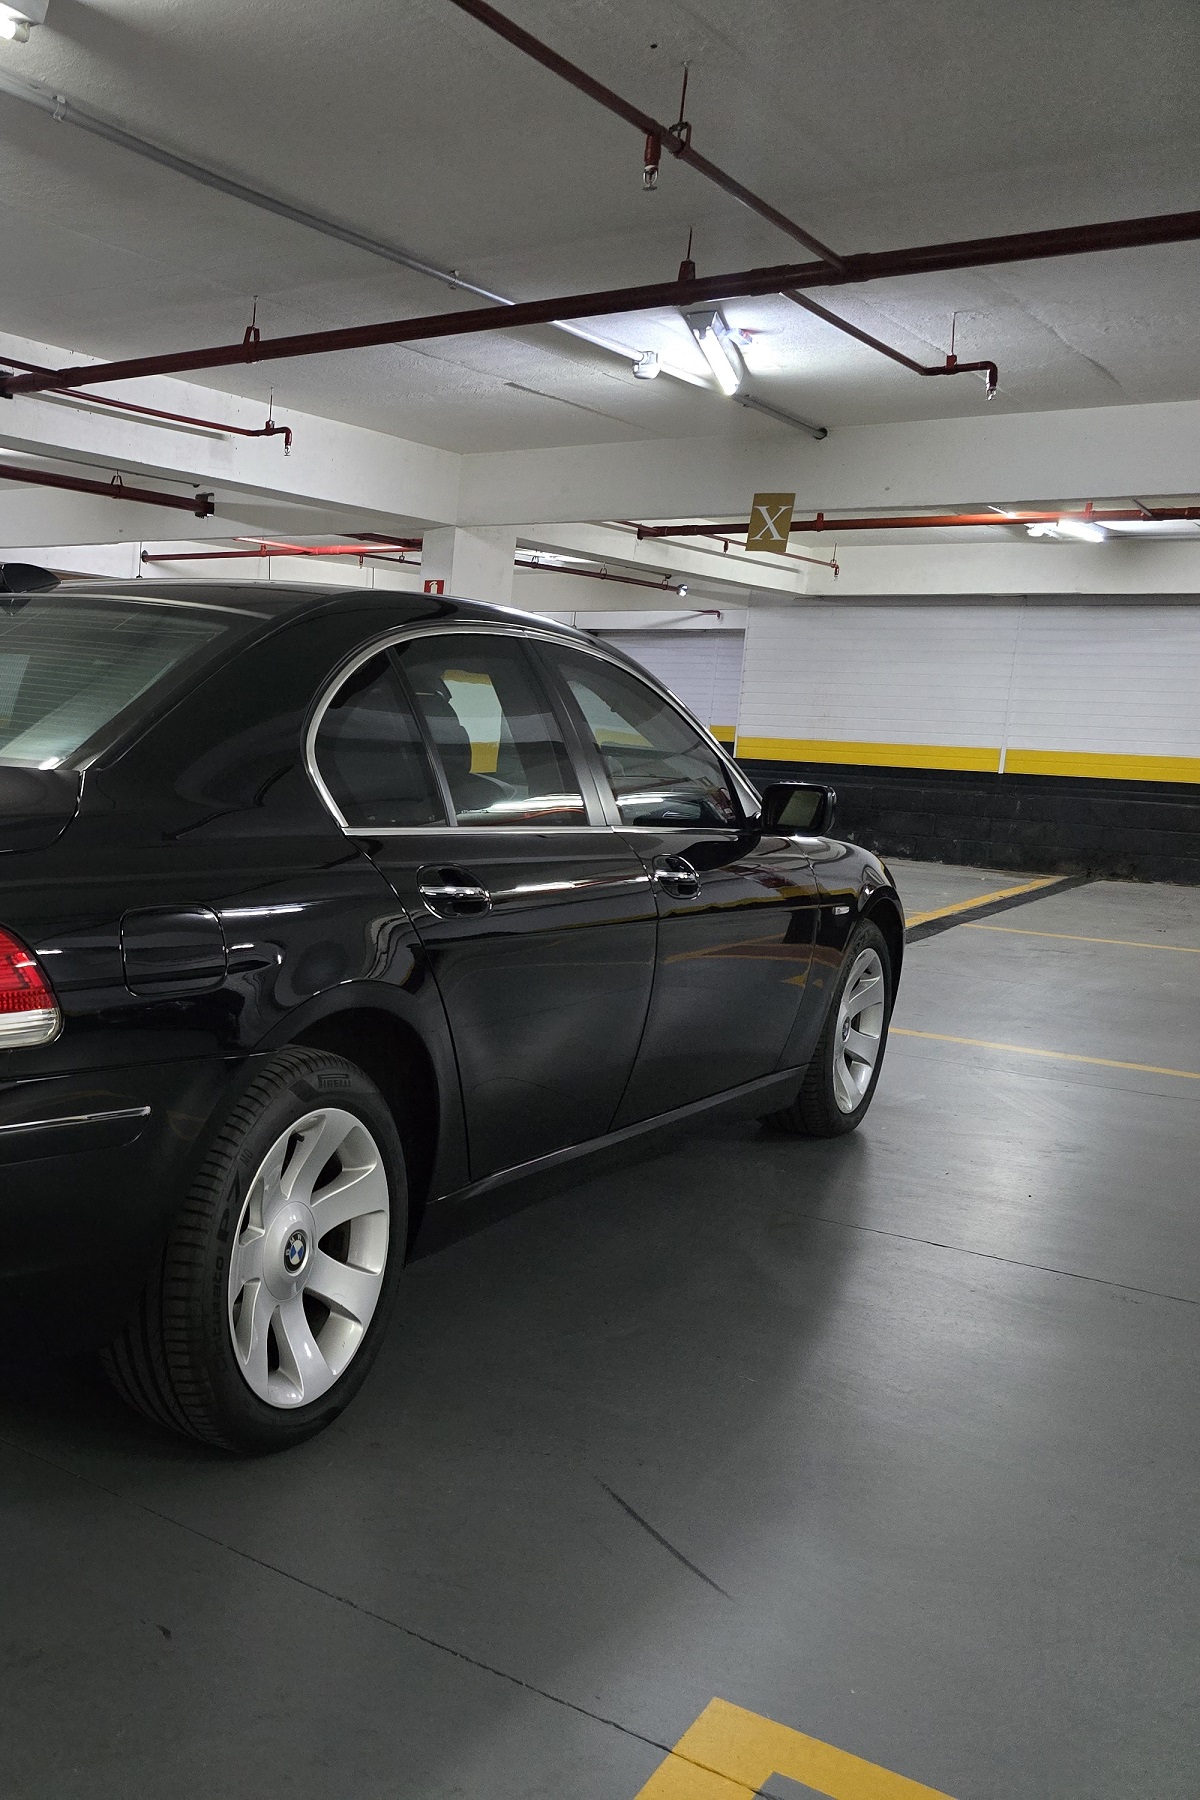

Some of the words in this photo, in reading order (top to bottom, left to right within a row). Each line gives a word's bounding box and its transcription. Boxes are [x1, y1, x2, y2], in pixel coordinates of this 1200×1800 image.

[750, 505, 792, 541] X
[316, 1072, 353, 1090] PIRELLI
[216, 1169, 242, 1243] P7
[285, 1232, 303, 1257] BMW
